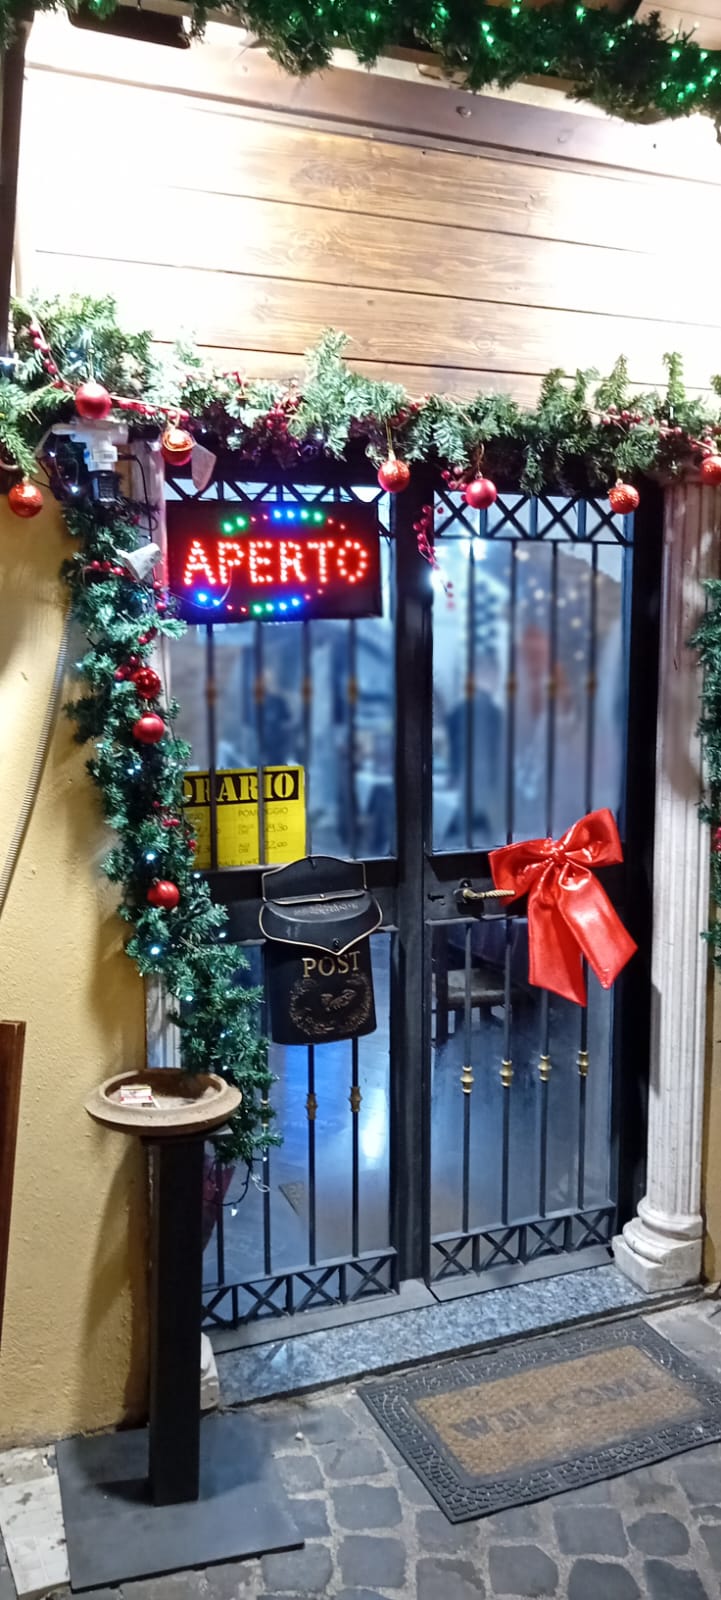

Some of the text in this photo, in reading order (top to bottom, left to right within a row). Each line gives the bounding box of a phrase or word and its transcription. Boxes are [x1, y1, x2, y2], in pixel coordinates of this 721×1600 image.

[183, 539, 368, 585] APERTO
[301, 950, 361, 978] POST
[449, 1371, 661, 1438] WELCOME
